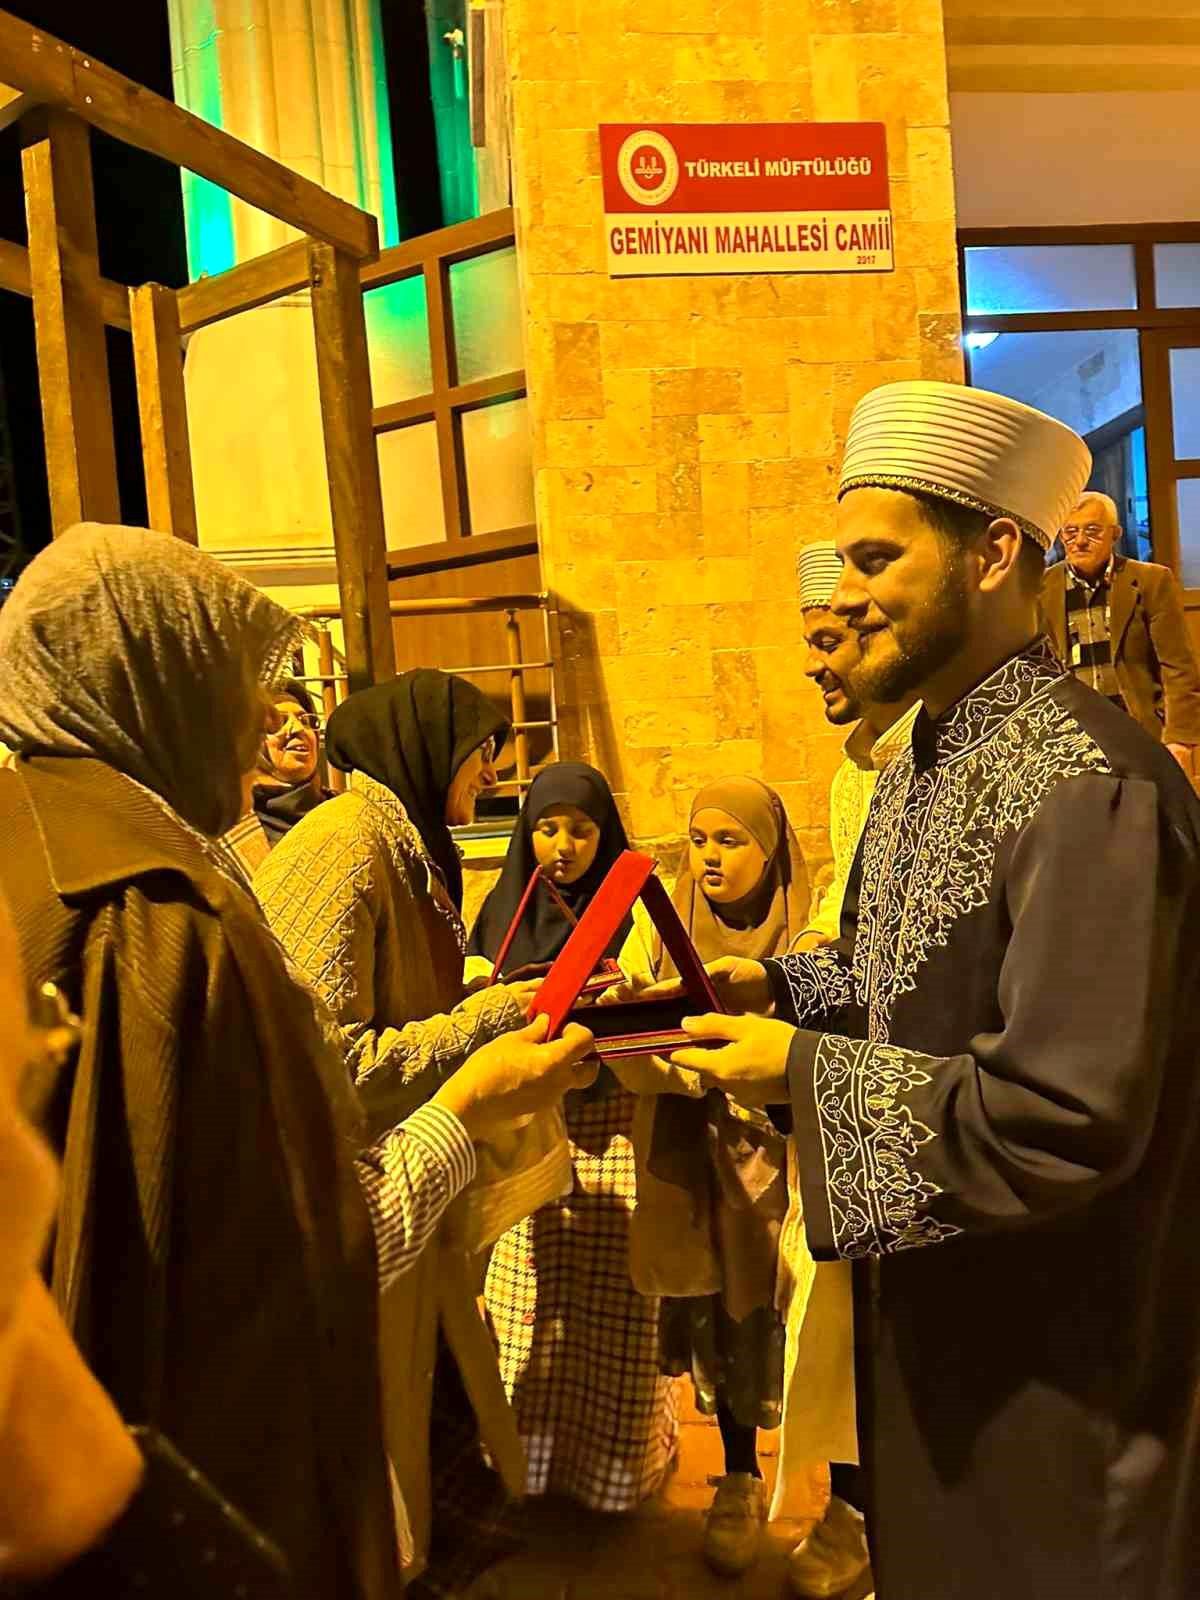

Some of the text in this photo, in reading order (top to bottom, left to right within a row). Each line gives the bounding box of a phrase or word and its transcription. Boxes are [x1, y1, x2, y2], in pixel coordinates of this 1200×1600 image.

[684, 156, 872, 177] TÜRKELİ MÜFTÜLÜĞÜ
[610, 216, 890, 255] GEMİYANI MAHALLESİ CAMİİ
